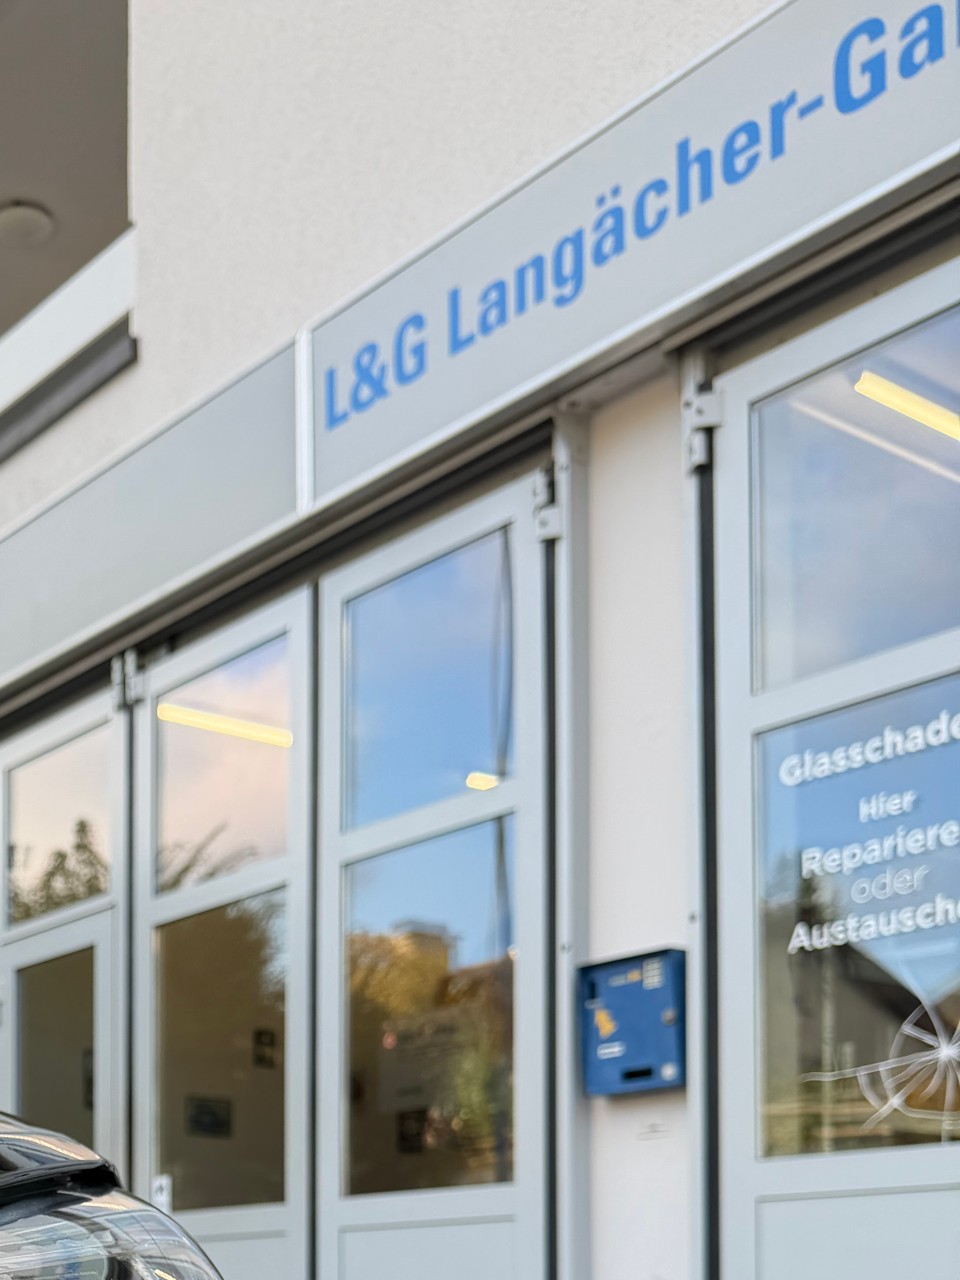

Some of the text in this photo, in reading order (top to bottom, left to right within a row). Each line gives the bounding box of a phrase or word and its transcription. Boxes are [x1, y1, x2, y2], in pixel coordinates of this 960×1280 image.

[324, 2, 960, 432] L&G Langächer-Ga
[859, 789, 917, 823] Hier
[801, 819, 960, 879] Repariere
[851, 864, 930, 904] oder
[787, 892, 960, 954] Austausch
